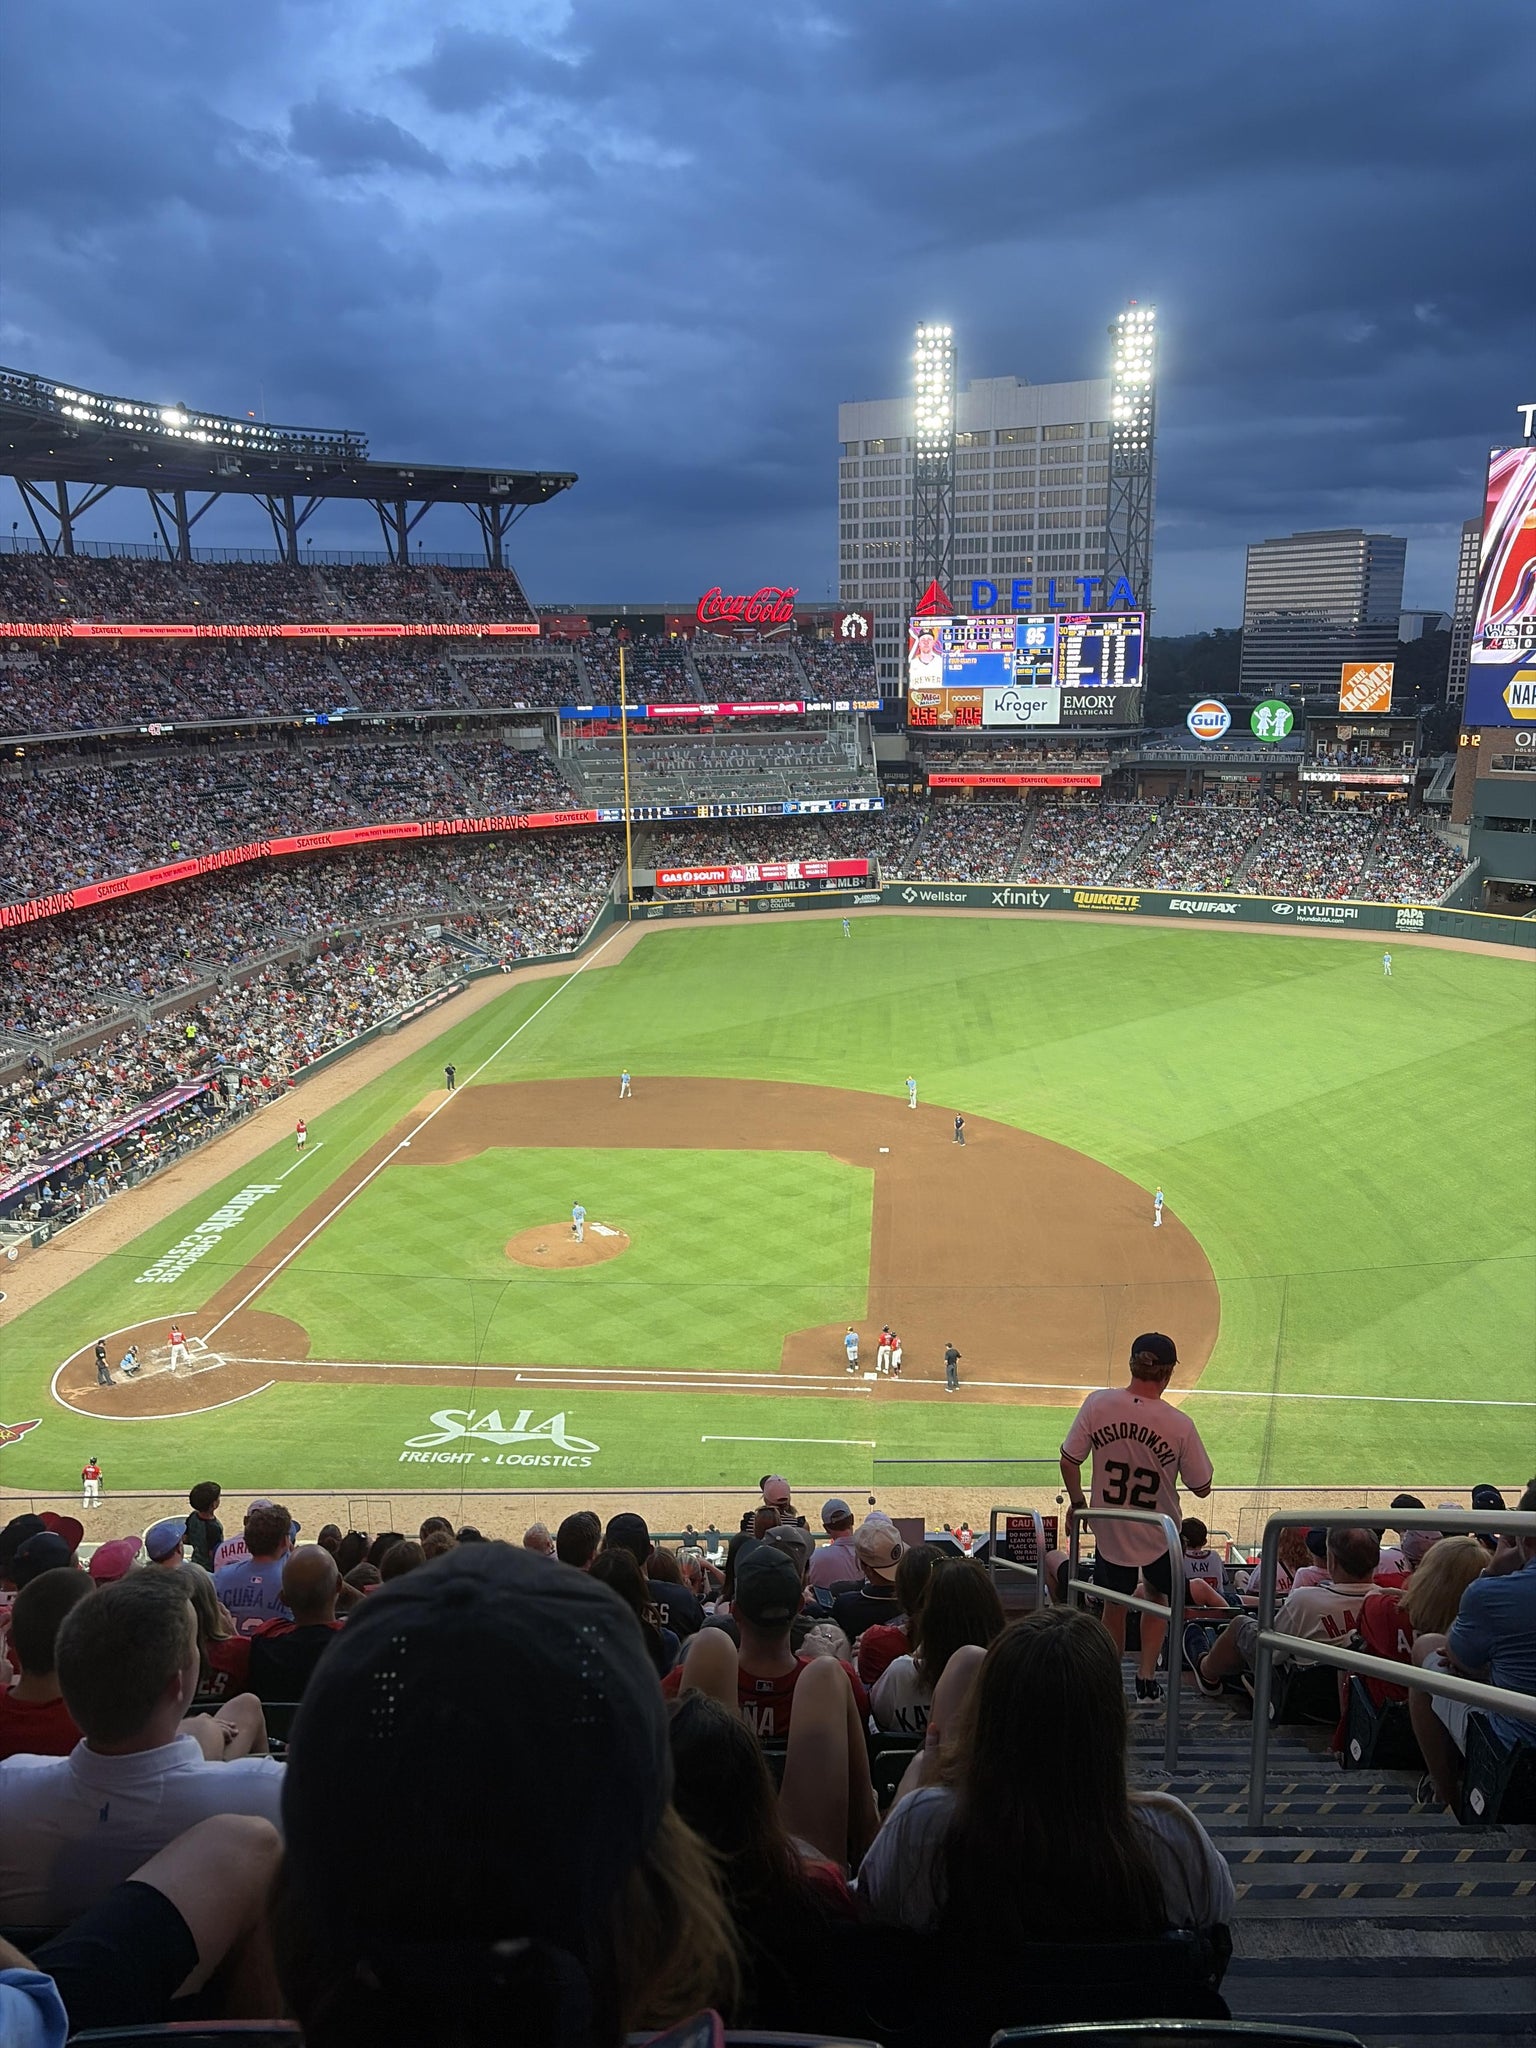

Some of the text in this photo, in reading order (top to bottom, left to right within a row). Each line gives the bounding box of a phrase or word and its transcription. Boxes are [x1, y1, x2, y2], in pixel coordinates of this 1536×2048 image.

[972, 576, 1137, 610] DELTA
[696, 586, 799, 624] Coca-Cola
[91, 626, 122, 635] SEATGEEK
[420, 624, 458, 636] ATLANTA
[459, 624, 490, 636] BRAVES
[1346, 668, 1369, 688] THE
[1340, 663, 1393, 711] HOME
[1063, 695, 1117, 708] EMORY
[1359, 681, 1391, 711] DEPOT
[911, 707, 937, 719] 452
[956, 707, 982, 719] 302
[995, 691, 1048, 721] Kroger
[1190, 714, 1227, 726] Gulf
[420, 814, 529, 836] THE ATLANTA BRAVES
[555, 812, 590, 823] SEATGEEK
[296, 834, 332, 849] SEATGEEK
[662, 870, 725, 883] GAS SOUTH
[837, 876, 866, 887] MLB+
[97, 880, 130, 898] SEATGEEK
[719, 884, 747, 894] MLB+
[784, 880, 811, 891] MLB+
[920, 891, 967, 902] Wellstar
[992, 888, 1050, 907] xfinity
[1073, 891, 1141, 907] QUIKRETE
[36, 891, 75, 920] BRAVES
[1169, 899, 1238, 914] EQUIFAX
[1297, 905, 1359, 919] HYUNDAI
[1296, 916, 1345, 924] HyundaiUSA.com
[1397, 909, 1424, 919] PAPA
[1395, 917, 1425, 927] JOHNS
[194, 1184, 283, 1234] Harrah's
[134, 1234, 204, 1284] CASINOS
[153, 1234, 223, 1284] CHEROKEE
[404, 1409, 601, 1453] SAIA
[1090, 1422, 1176, 1467] MISIOROWSKI
[398, 1451, 476, 1464] FREIGHT
[495, 1454, 592, 1467] LOGISTICS
[1102, 1459, 1161, 1510] 32
[1191, 1562, 1210, 1574] KAY
[217, 1586, 264, 1608] CUÑA
